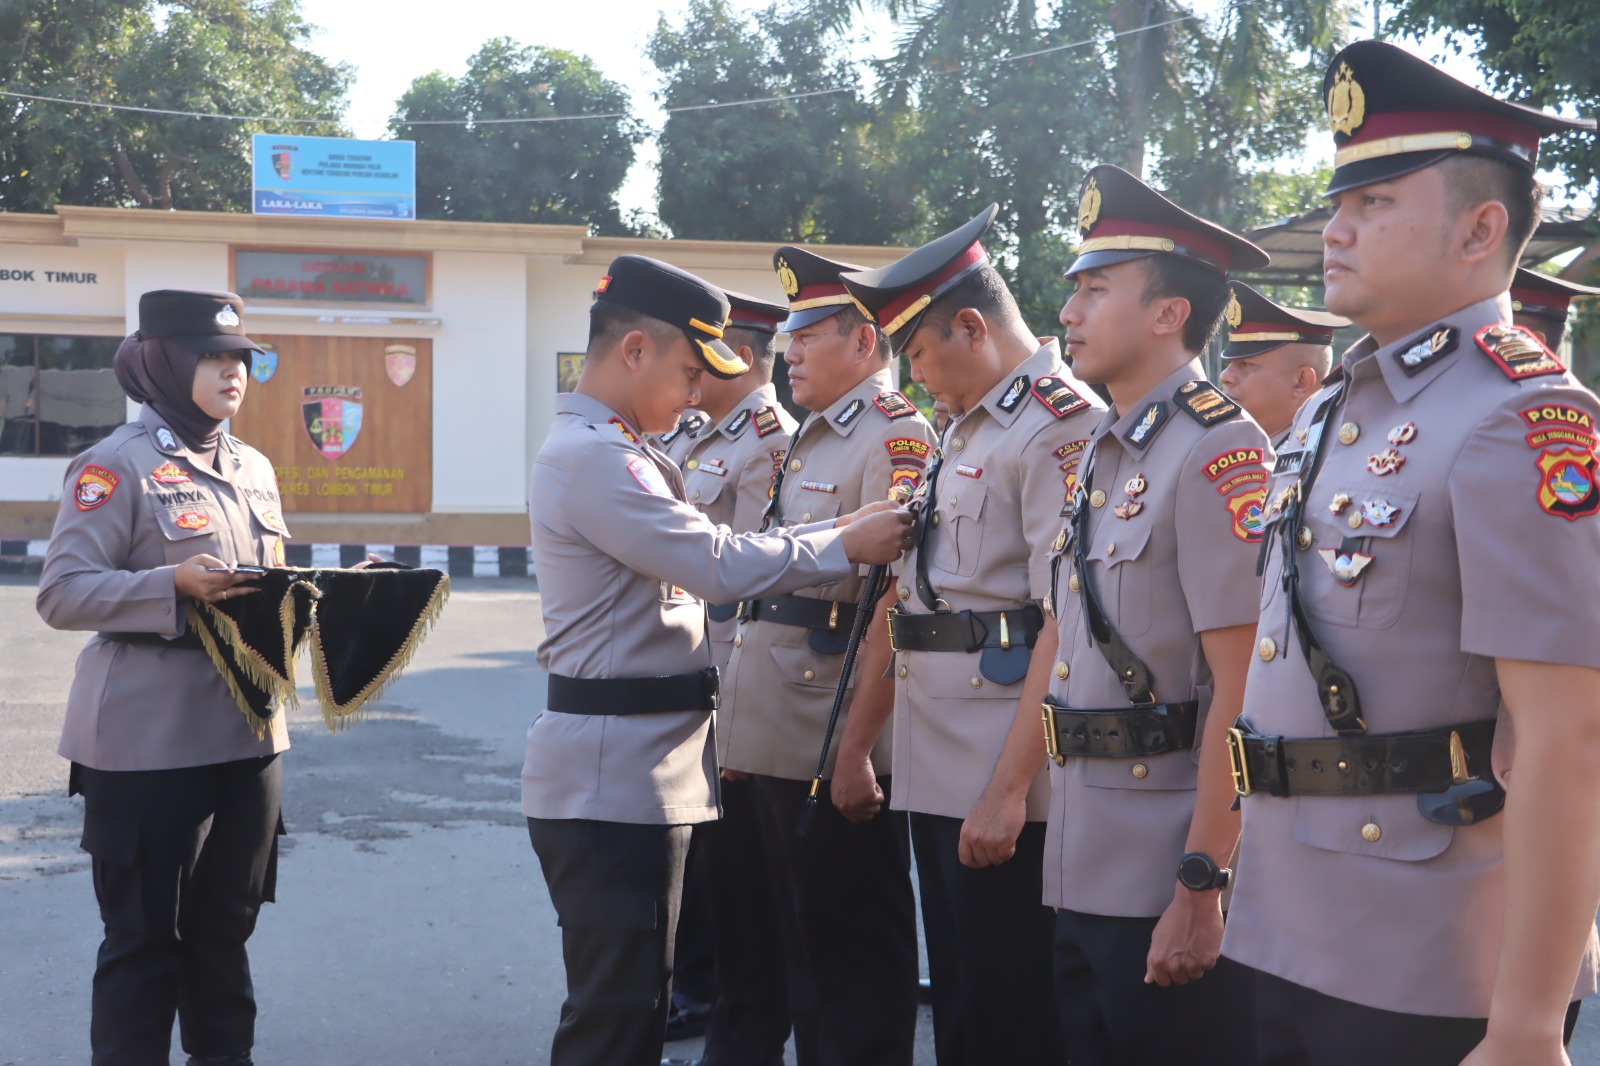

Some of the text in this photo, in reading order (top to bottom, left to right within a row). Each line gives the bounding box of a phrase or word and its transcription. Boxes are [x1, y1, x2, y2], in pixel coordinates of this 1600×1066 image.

[261, 199, 324, 210] LAKA-LAKA
[0, 269, 98, 284] BOK TIMUR
[252, 277, 326, 294] PARAMA
[1527, 407, 1590, 428] POLDA
[888, 439, 928, 451] POLRES
[1208, 450, 1259, 476] POLDA
[307, 467, 329, 479] DAN
[335, 467, 405, 479] PENGAMANAN
[157, 489, 207, 505] WIDYA
[244, 488, 280, 503] POLRI
[317, 483, 357, 496] LOMBOK
[365, 483, 394, 496] TIMUR
